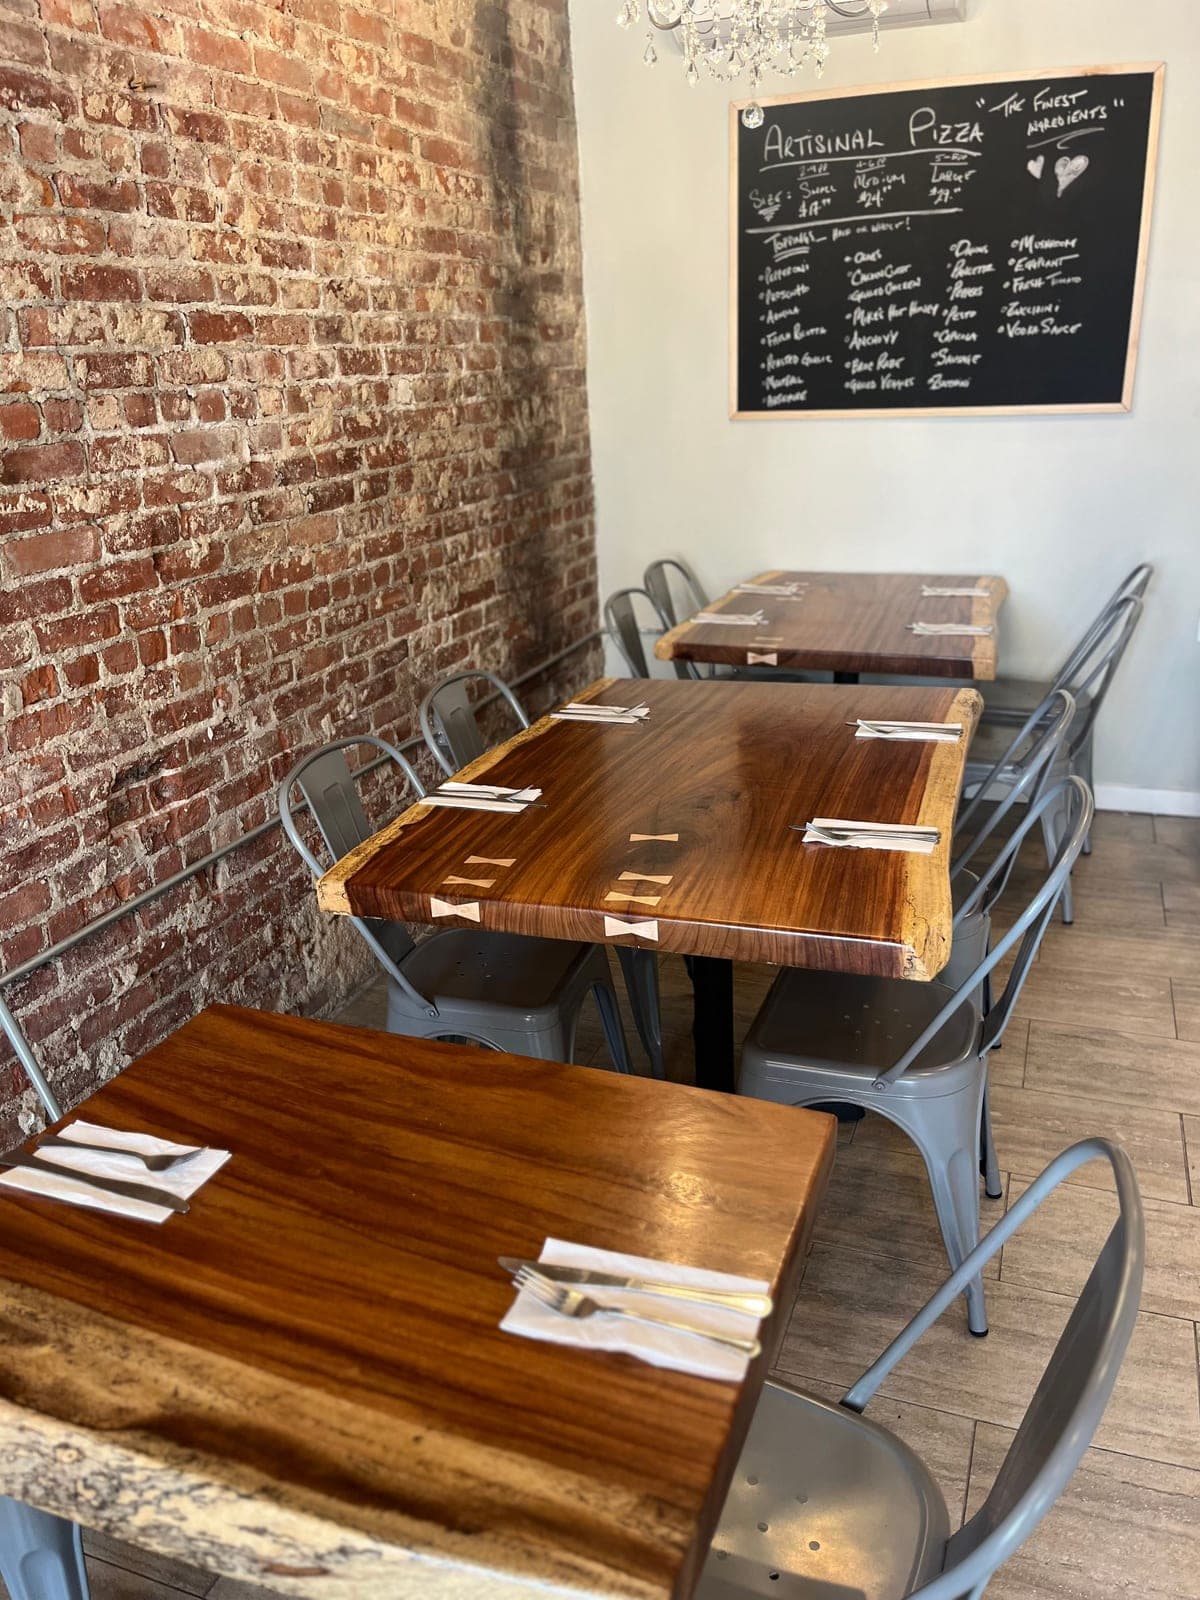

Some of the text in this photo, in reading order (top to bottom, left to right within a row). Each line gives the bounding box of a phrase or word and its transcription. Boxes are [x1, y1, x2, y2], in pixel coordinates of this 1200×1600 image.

[1033, 86, 1088, 112] FINEST
[764, 106, 984, 161] ARTISINAL PIZZA
[1040, 317, 1082, 335] SAUCE
